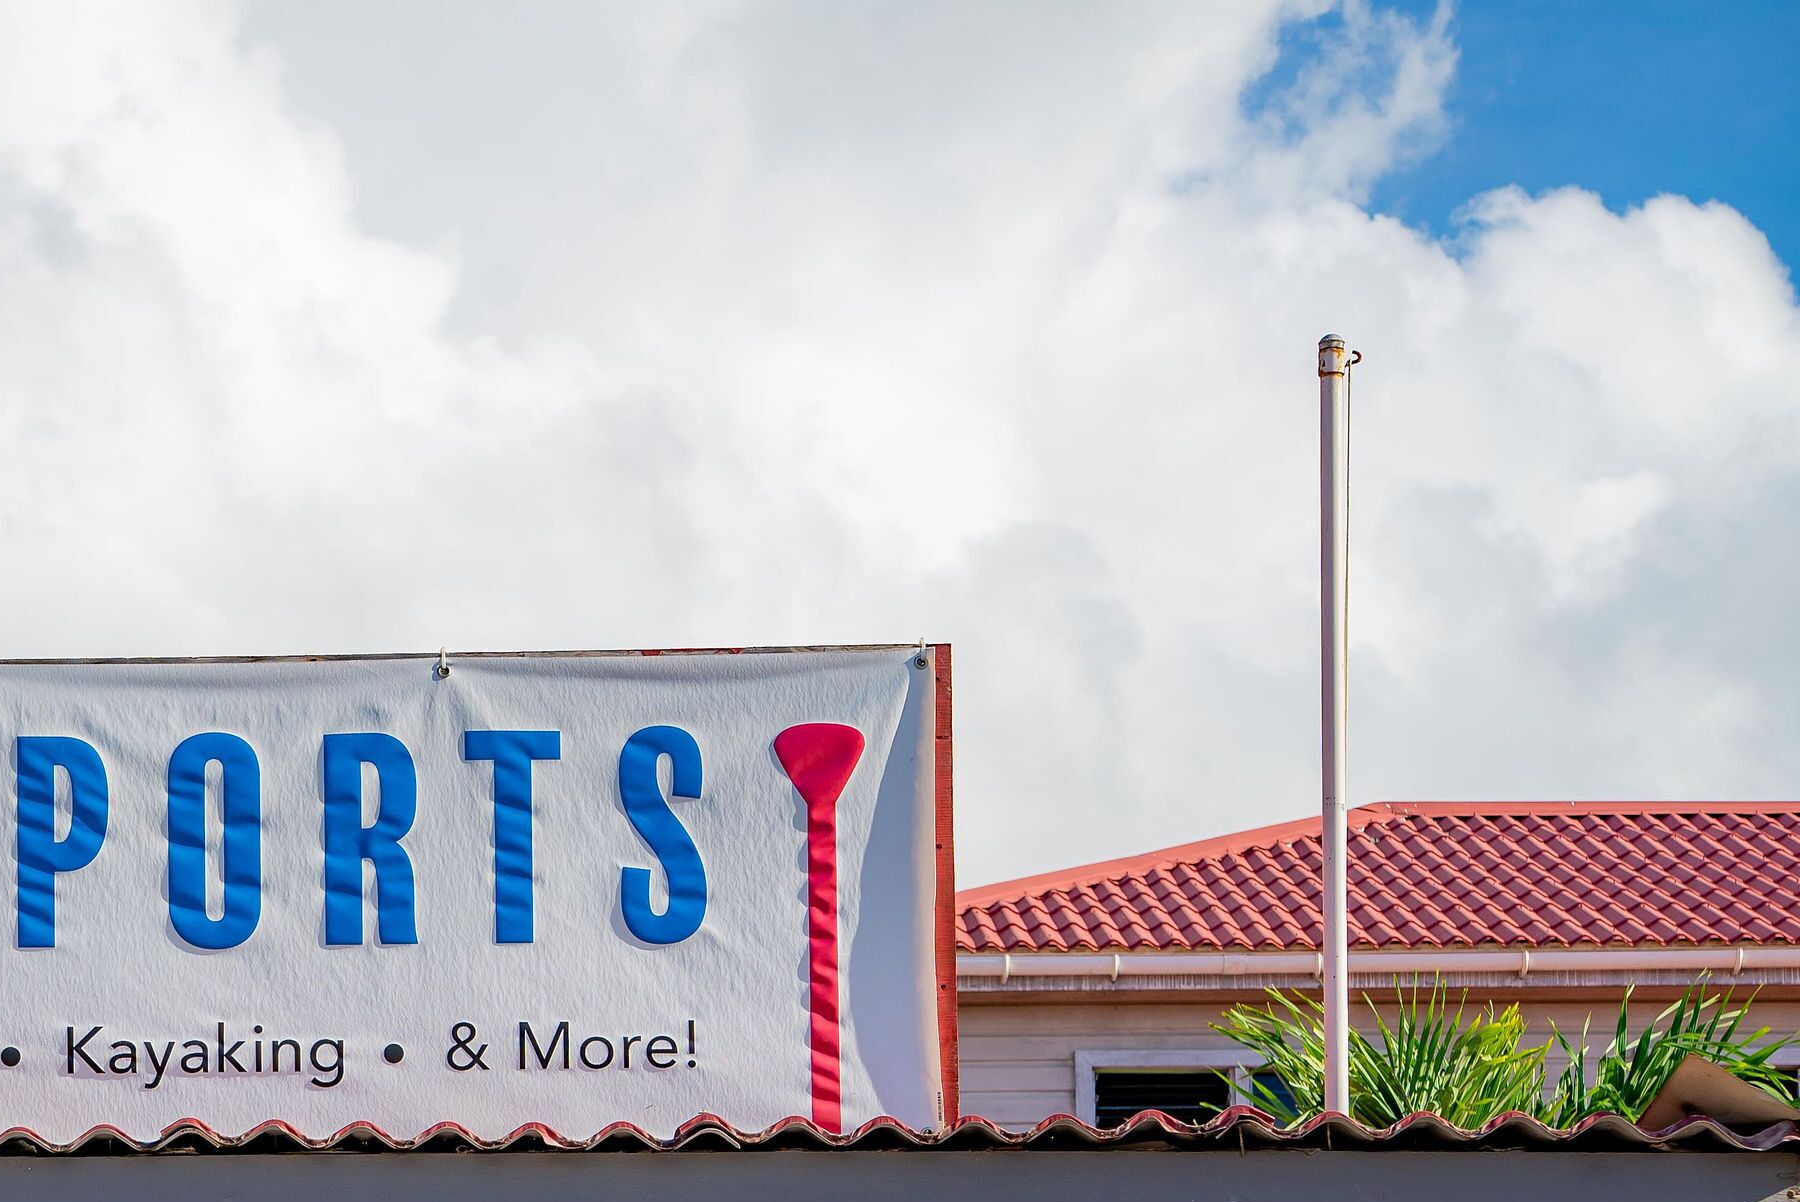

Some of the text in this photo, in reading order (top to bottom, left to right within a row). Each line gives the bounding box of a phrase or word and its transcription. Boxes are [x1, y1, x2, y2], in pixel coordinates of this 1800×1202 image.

[66, 1022, 346, 1090] Kayaking
[446, 1021, 490, 1071] &
[518, 1020, 699, 1070] More!
